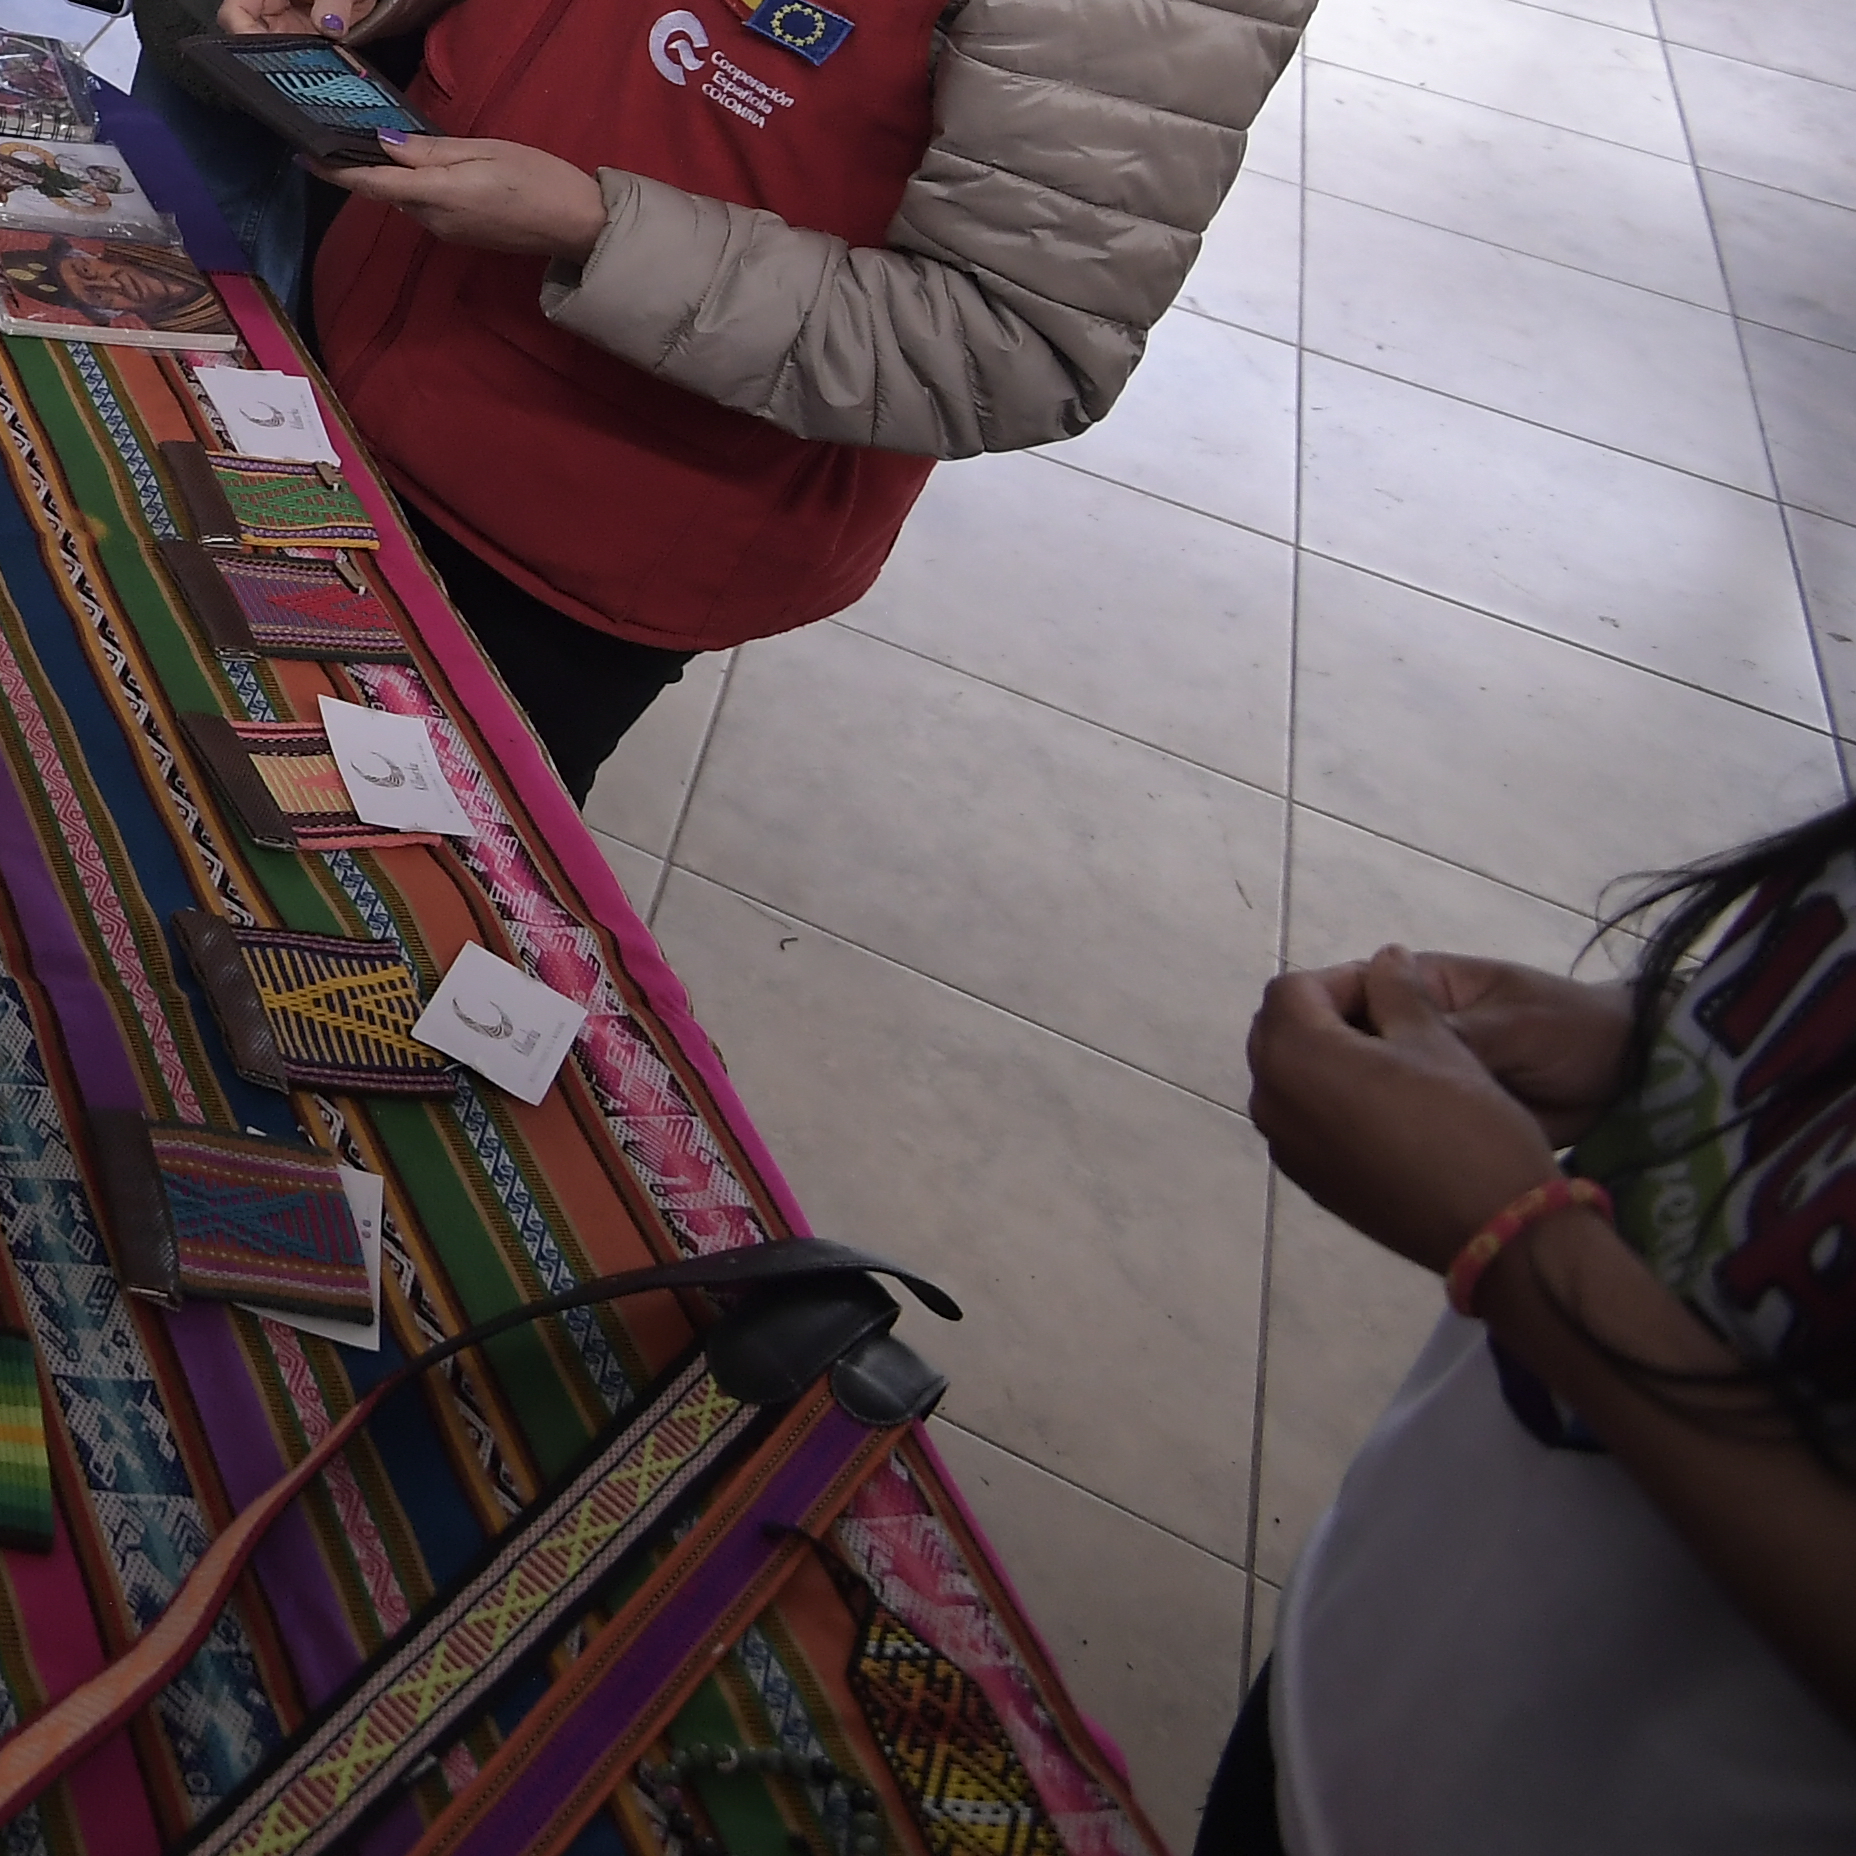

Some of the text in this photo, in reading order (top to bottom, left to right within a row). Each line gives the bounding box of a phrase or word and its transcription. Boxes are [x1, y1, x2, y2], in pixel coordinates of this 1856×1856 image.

[711, 51, 795, 107] Cooperación
[712, 70, 773, 114] Española
[702, 83, 765, 129] COLOMBIA
